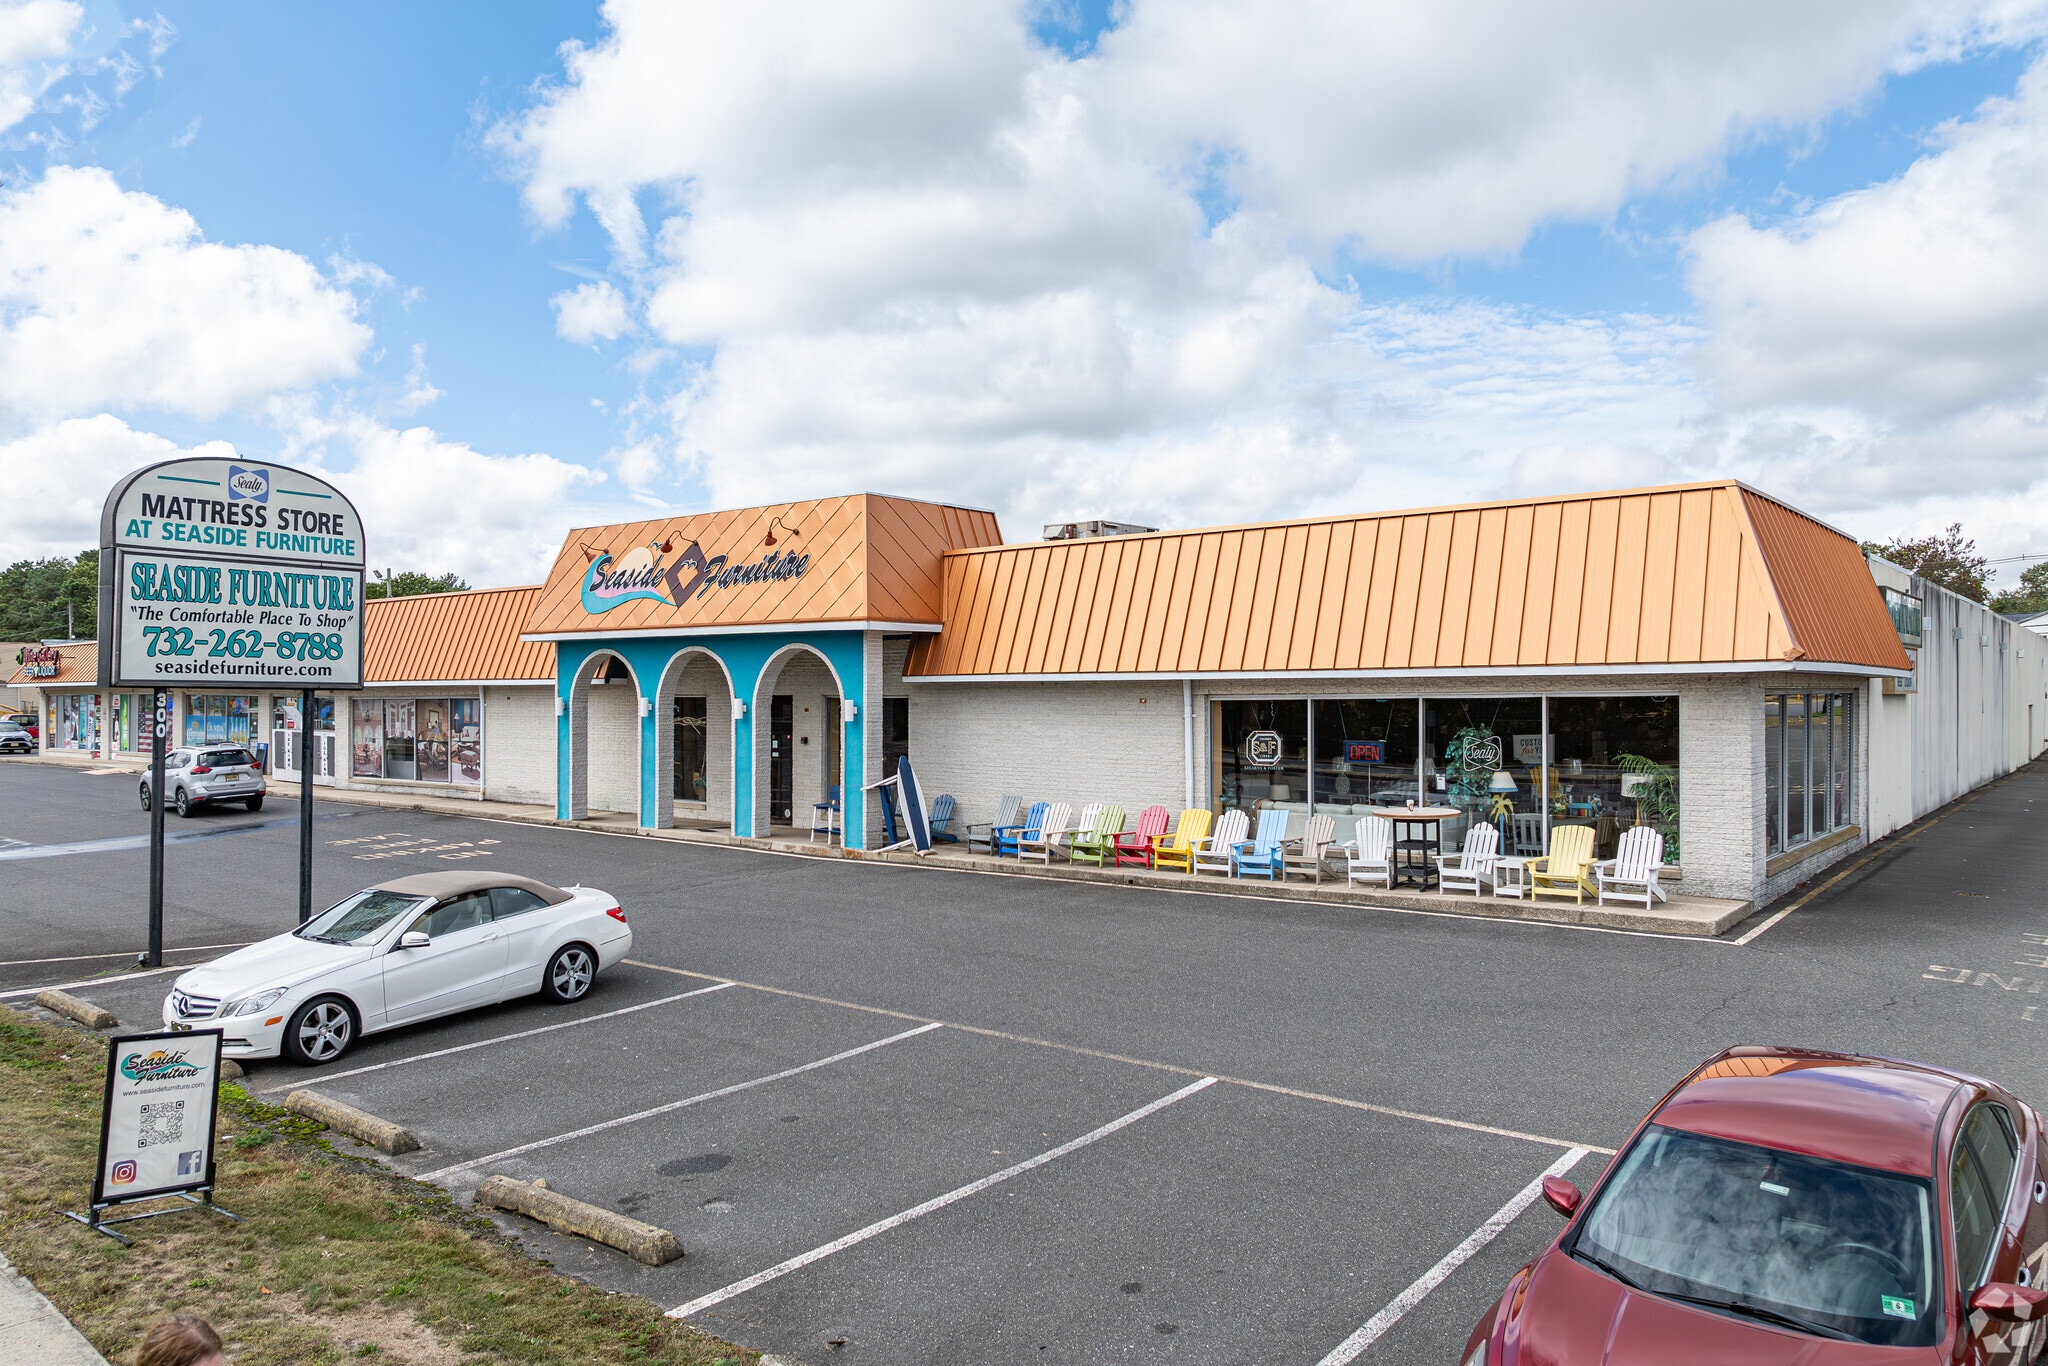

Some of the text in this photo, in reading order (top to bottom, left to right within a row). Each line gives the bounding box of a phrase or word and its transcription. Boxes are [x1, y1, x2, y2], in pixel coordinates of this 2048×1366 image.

[141, 493, 344, 536] MATTRESS STORE
[125, 519, 355, 557] AT SEASIDE FURNITURE
[588, 549, 810, 601] Seaside Furniture
[131, 562, 354, 611] SEASIDE FURNITURE
[170, 607, 254, 624] Comfortable
[259, 610, 293, 626] Place
[298, 613, 311, 627] To
[142, 625, 343, 661] 732-262-8788
[155, 659, 332, 676] seasidefurniture.com
[156, 692, 167, 738] 300
[1253, 740, 1277, 755] S&F
[1349, 744, 1380, 761] OPEN
[125, 1050, 184, 1071] Seaside
[134, 1066, 199, 1087] Furniture
[122, 1081, 206, 1097] www.seasidefurniture.com
